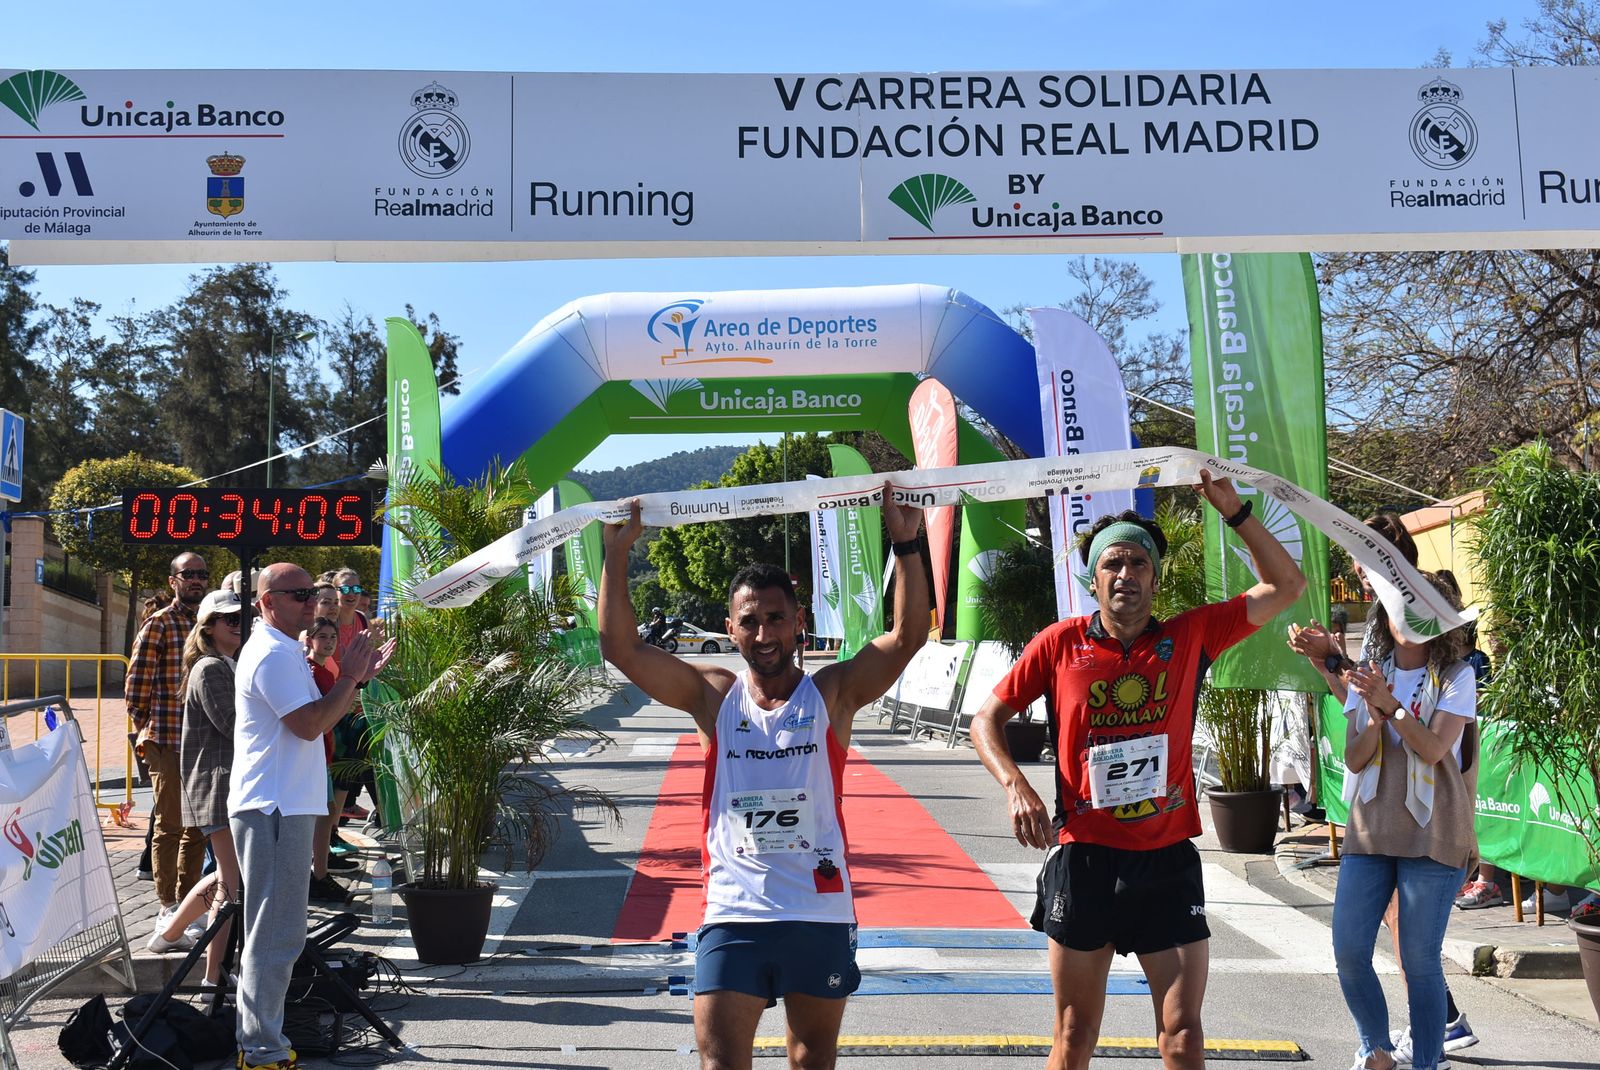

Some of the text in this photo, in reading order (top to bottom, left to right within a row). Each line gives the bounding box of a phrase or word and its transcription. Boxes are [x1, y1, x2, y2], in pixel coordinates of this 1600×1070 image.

[774, 73, 1271, 111] V CARRERA SOLIDARIA
[81, 100, 285, 133] Unicaja Banco
[738, 116, 1319, 158] FUNDACIÓN REAL MADRID
[375, 186, 494, 197] FUNDACIÓN
[1008, 174, 1045, 195] BY
[1390, 176, 1505, 188] FUNDACIÓN
[530, 182, 694, 226] Running
[1390, 188, 1505, 208] Realmadrid
[63, 205, 125, 218] Provincial
[375, 199, 494, 217] Realmadrid
[972, 202, 1163, 232] Unicaja Banco
[25, 221, 92, 236] de Málaga
[188, 228, 221, 236] Alhaurín
[223, 228, 234, 236] de
[236, 228, 243, 236] la
[194, 220, 257, 229] Ayuntamiento de
[704, 315, 877, 338] Area de Deportes
[705, 336, 877, 355] Ayto. Alhaurín de la Torre
[700, 388, 862, 414] Unicaja Banco
[1028, 473, 1101, 487] Diputación Provincial
[1047, 467, 1084, 476] de Málaga
[671, 501, 730, 517] Running
[741, 496, 784, 506] Realmadrid
[818, 491, 936, 509] Unica Banco
[129, 493, 363, 540] 00:34:05
[550, 526, 560, 536] de
[1332, 520, 1416, 604] Unicaja Banco
[1090, 704, 1168, 728] WOMAN
[1107, 755, 1159, 781] 271
[1487, 797, 1520, 814] Banco
[743, 809, 799, 829] 176
